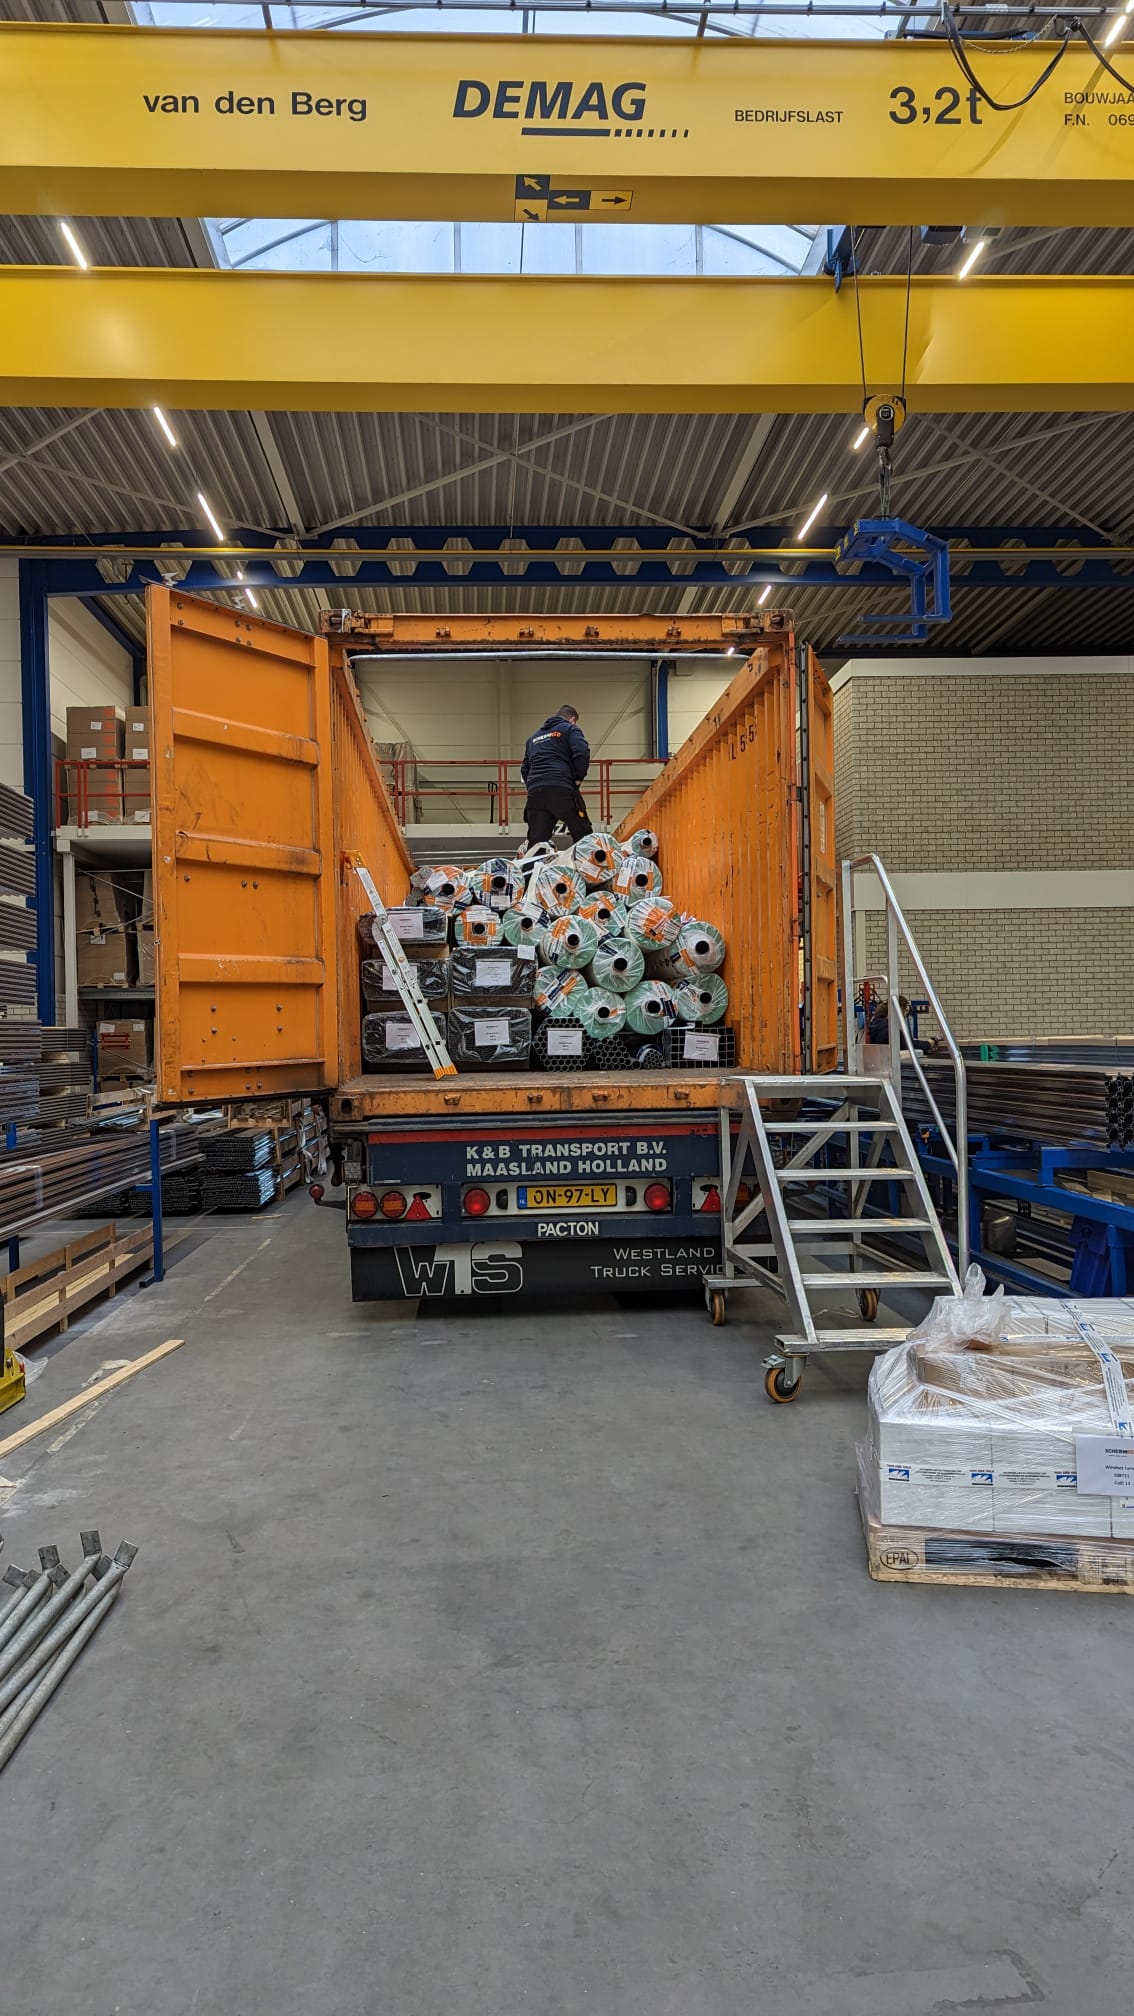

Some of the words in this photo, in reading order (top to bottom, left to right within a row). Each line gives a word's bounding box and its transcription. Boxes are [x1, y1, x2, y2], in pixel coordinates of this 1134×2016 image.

[143, 95, 200, 113] van
[214, 91, 275, 115] den
[291, 91, 367, 122] Berg
[452, 79, 647, 121] DEMAG
[889, 86, 983, 125] 3,2t
[734, 109, 844, 123] BEDRIJFSLAST
[1064, 113, 1090, 126] F.N.
[519, 1142, 630, 1158] TRANSPORT
[636, 1141, 667, 1155] B.V.
[466, 1160, 572, 1177] MAASLAND
[577, 1158, 667, 1174] HOLLAND
[537, 1221, 599, 1237] PACTON
[613, 1247, 715, 1260] WESTLAND
[590, 1265, 652, 1279] TRUCK
[660, 1263, 726, 1276] SERVIC
